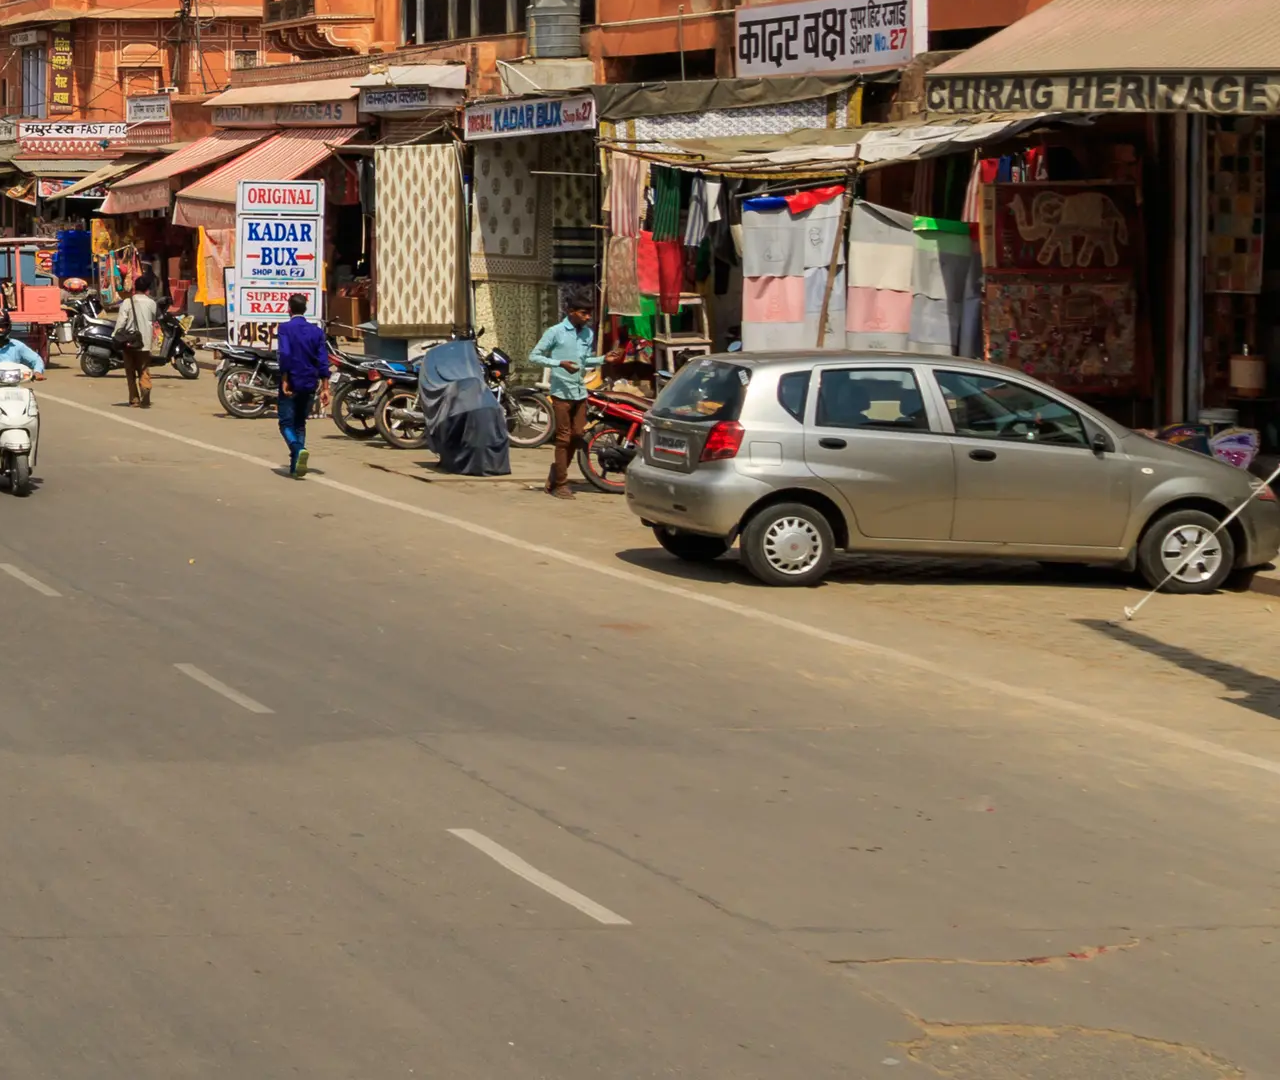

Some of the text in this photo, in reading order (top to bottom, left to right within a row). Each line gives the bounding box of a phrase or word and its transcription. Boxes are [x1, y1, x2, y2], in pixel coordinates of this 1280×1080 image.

[850, 33, 872, 55] SHOP
[927, 76, 1268, 111] CHIRAG HERITAGE
[494, 104, 534, 132] KADAR
[536, 100, 562, 128] BUX
[108, 124, 127, 135] FOO
[248, 188, 314, 205] ORIGINAL
[247, 223, 312, 242] KADAR
[260, 247, 298, 266] BUX
[252, 268, 272, 276] SHOP
